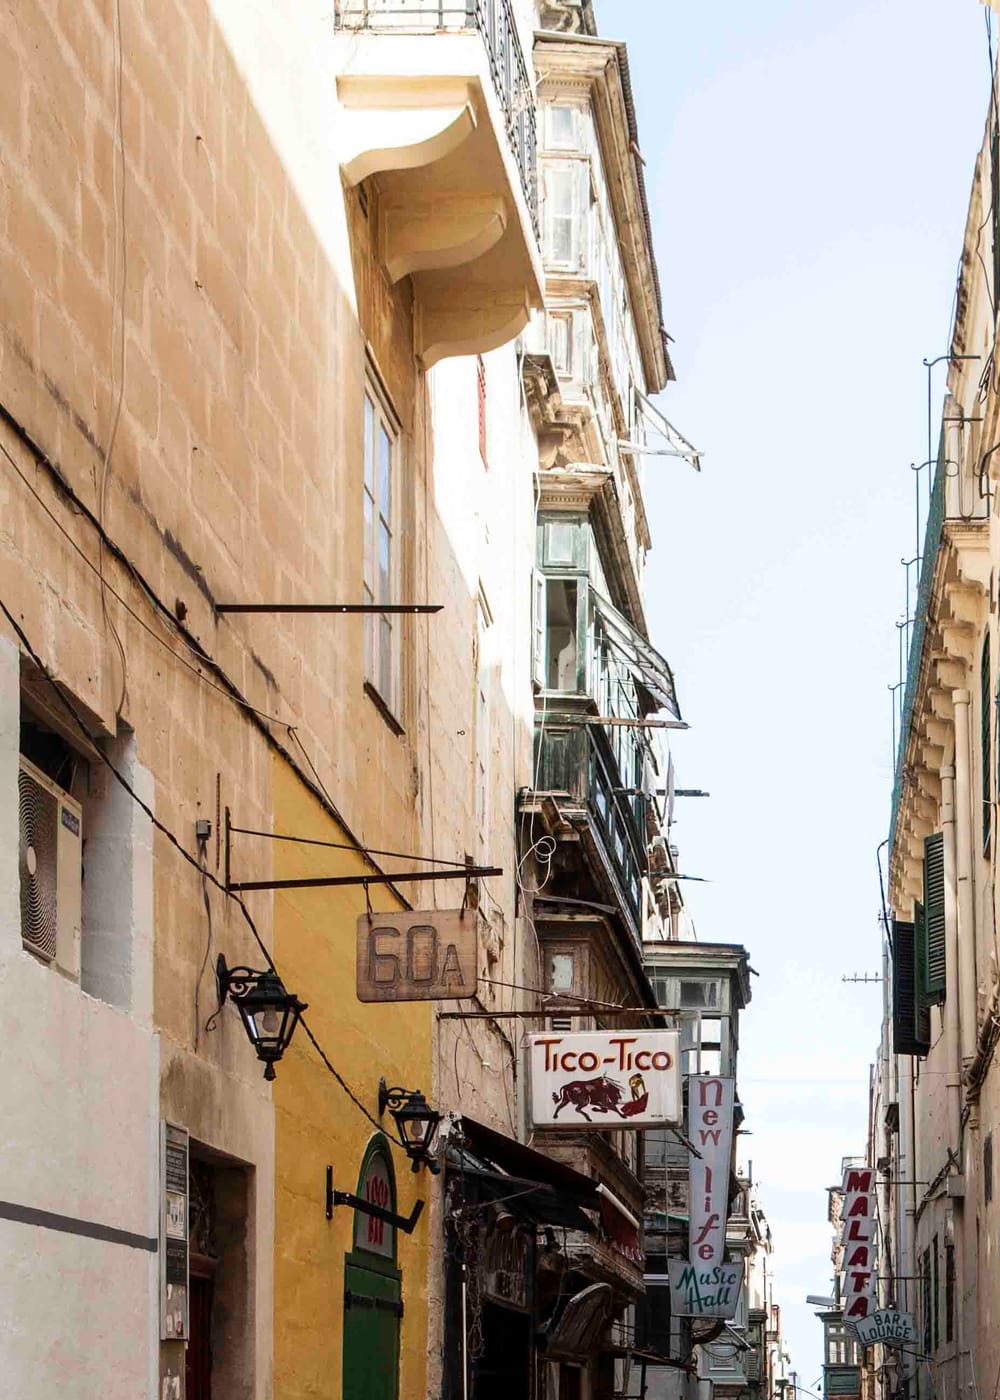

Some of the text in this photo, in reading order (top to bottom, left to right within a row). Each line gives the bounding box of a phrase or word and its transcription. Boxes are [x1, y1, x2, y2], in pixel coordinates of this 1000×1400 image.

[367, 925, 466, 988] 60A
[692, 1079, 723, 1260] new life
[846, 1171, 872, 1318] MALATA
[676, 1266, 737, 1291] Music
[686, 1286, 730, 1313] Hall
[862, 1324, 912, 1342] LOUNGE
[874, 1313, 899, 1327] BAR
